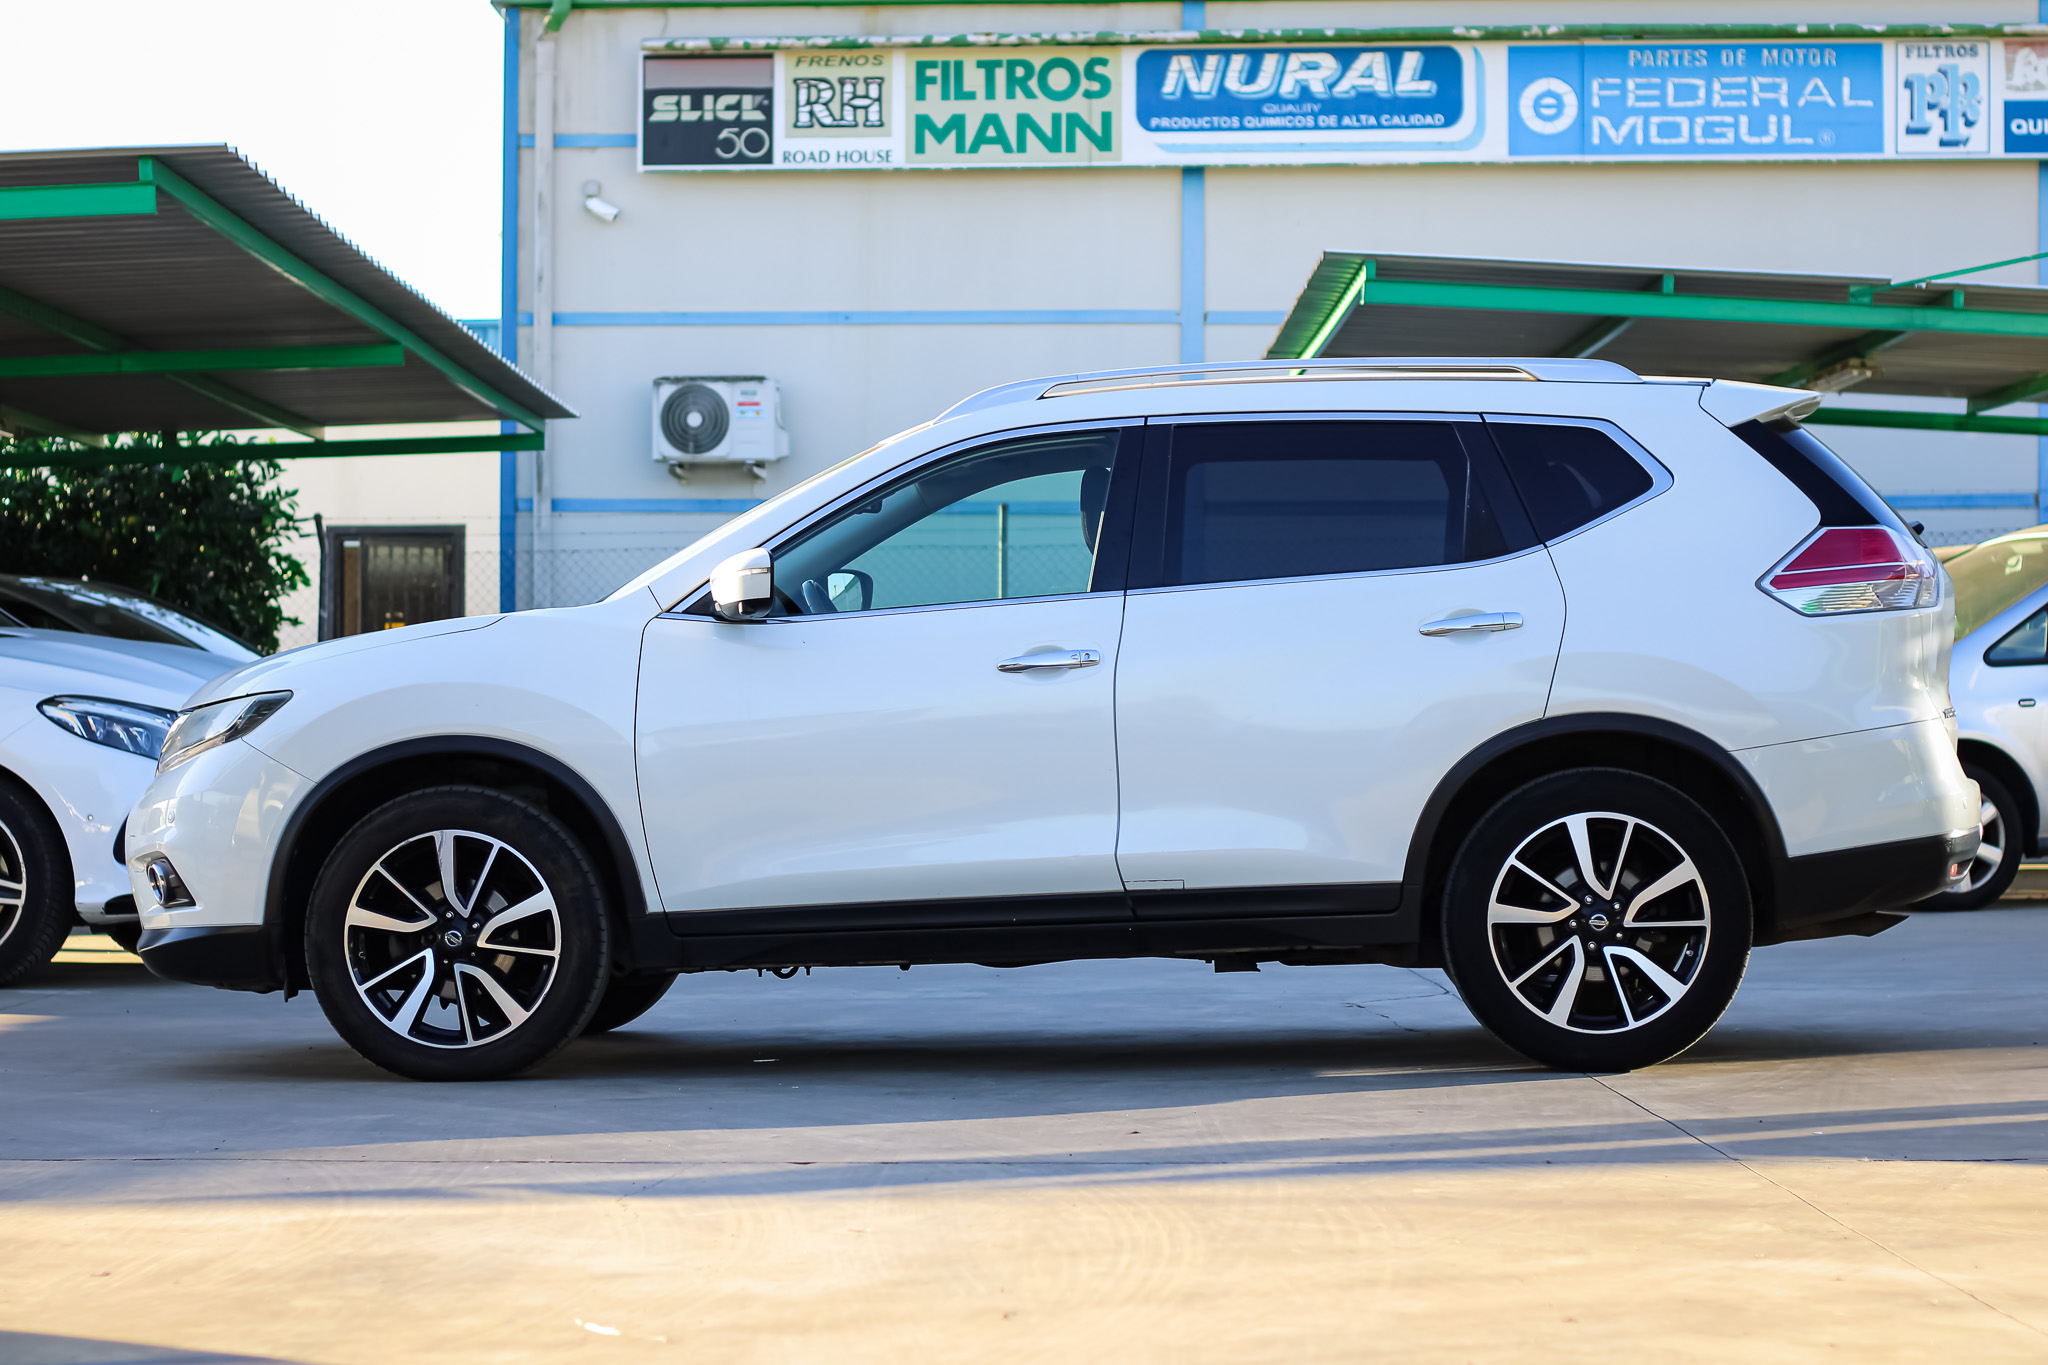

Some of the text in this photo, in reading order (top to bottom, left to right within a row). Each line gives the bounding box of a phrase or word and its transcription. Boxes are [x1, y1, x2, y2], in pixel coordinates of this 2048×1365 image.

[795, 55, 884, 67] FRENOS
[1629, 48, 1837, 67] PARTES DE MOTOR
[1906, 44, 1978, 58] FILTROS
[915, 56, 1112, 102] FILTROS
[1161, 51, 1438, 99] NURAL
[793, 77, 885, 128] RH
[1592, 76, 1874, 108] FEDERAL
[1150, 113, 1445, 129] PRODUCTOS QUIMICOS DE ALTA CALIDAD
[1261, 103, 1322, 114] QUALITY
[715, 127, 770, 159] 50
[915, 111, 1112, 154] MANN
[1592, 114, 1814, 145] MOGUL
[783, 149, 893, 164] ROAD HOUSE
